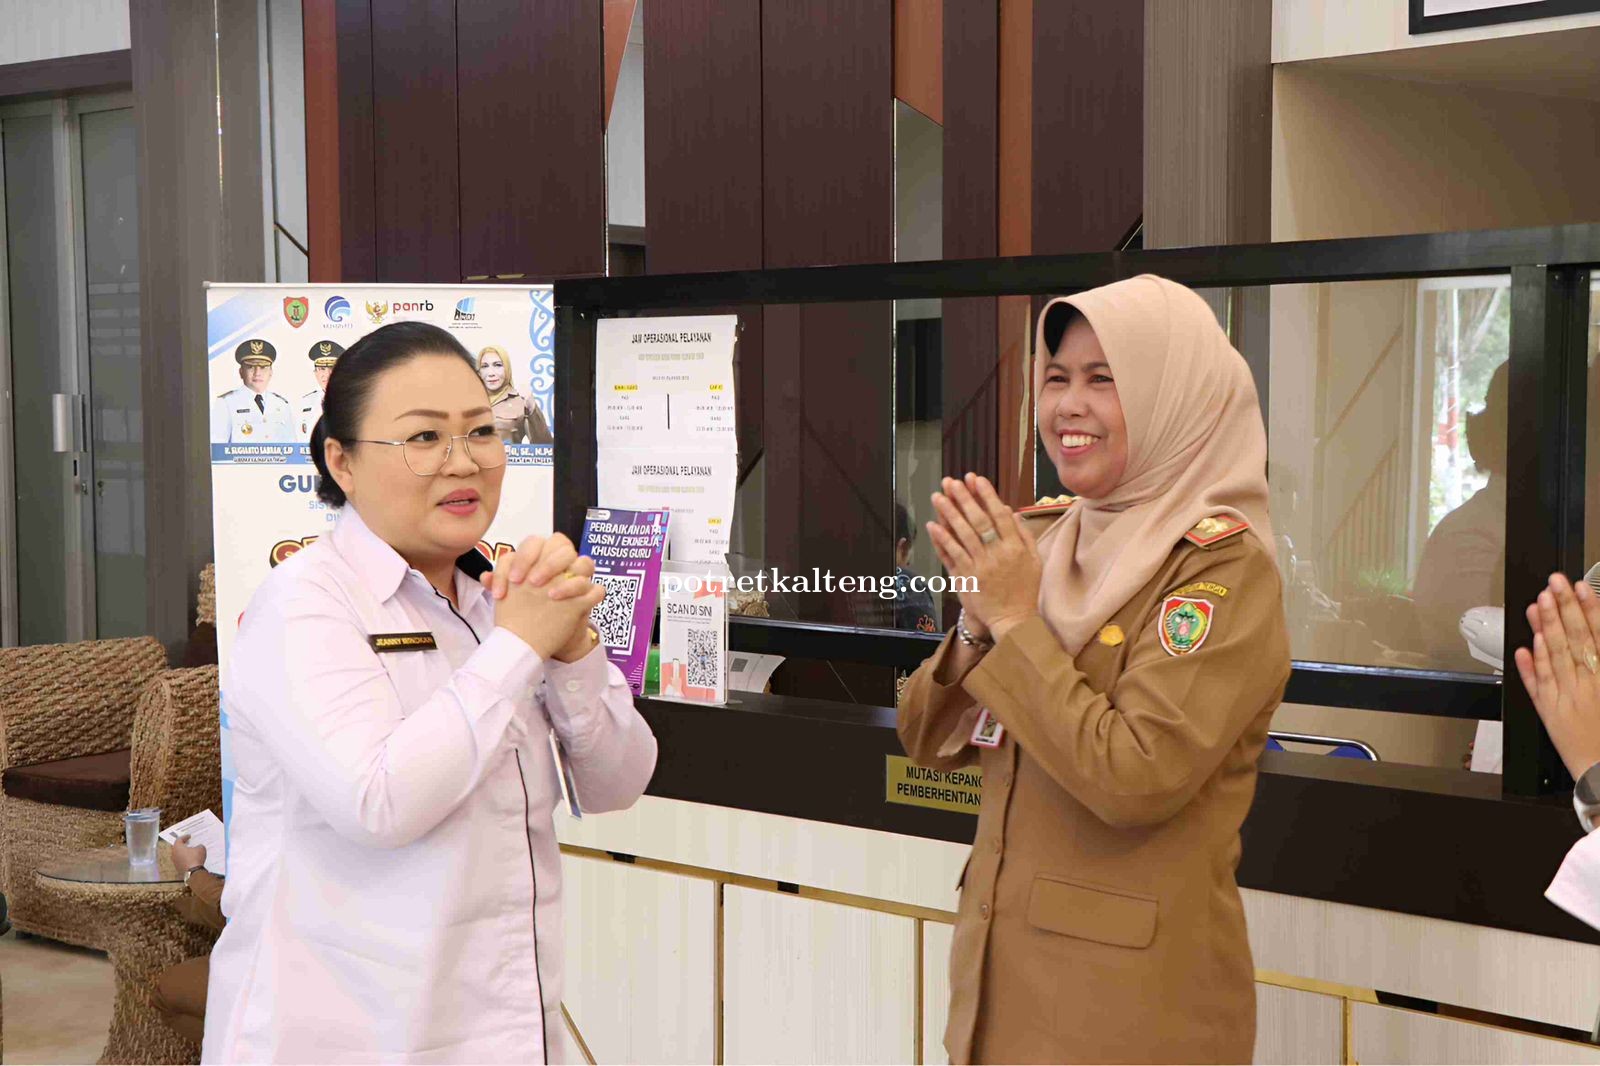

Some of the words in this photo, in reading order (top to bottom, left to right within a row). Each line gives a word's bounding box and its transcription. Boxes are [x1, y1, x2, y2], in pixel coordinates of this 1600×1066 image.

[392, 299, 434, 314] panrb
[643, 332, 679, 343] OPERASIONAL
[680, 332, 712, 343] PELAYANAN
[643, 465, 679, 476] OPERASIONAL
[680, 465, 712, 476] PELAYANAN
[589, 521, 640, 535] PERBAIKAN
[640, 524, 662, 535] DATA
[587, 533, 615, 545] SIASN
[621, 536, 660, 547] EKINERJA
[590, 545, 628, 558] KHUSUS
[629, 547, 652, 559] GURU
[667, 602, 689, 615] SCAN
[906, 766, 942, 783] MUTASI
[897, 783, 981, 806] PEMBERHENTIAN
